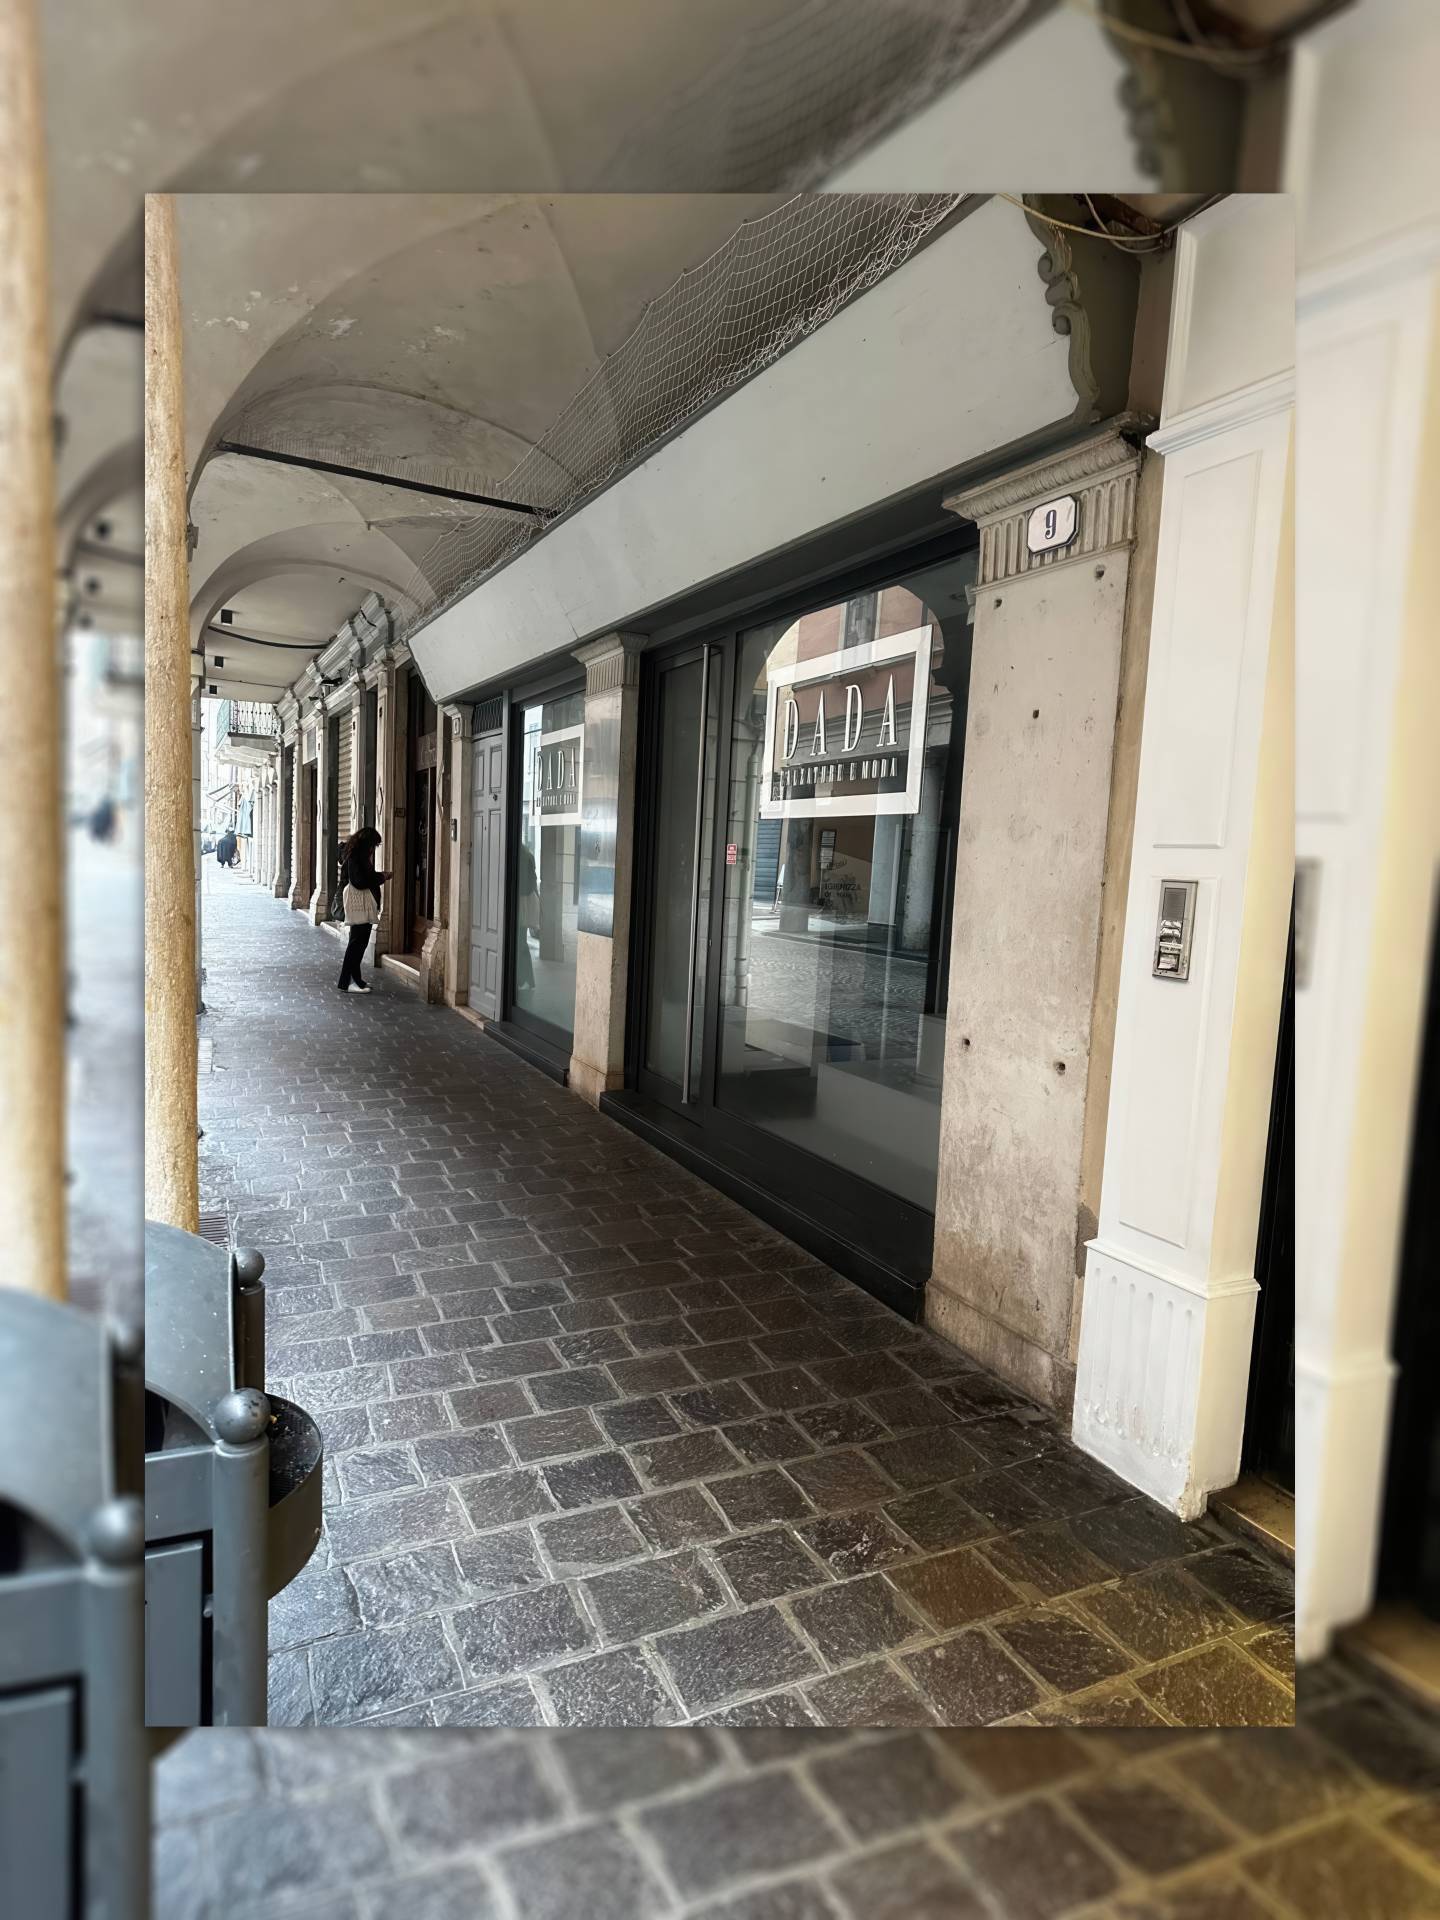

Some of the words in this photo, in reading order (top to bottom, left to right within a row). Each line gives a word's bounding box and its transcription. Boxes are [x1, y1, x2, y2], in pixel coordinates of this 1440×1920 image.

[1045, 509, 1057, 540] 9
[781, 673, 898, 761] DADA
[536, 747, 577, 792] DADA
[779, 763, 845, 788] CALZATURE
[849, 762, 859, 781] E
[861, 757, 898, 780] MODA
